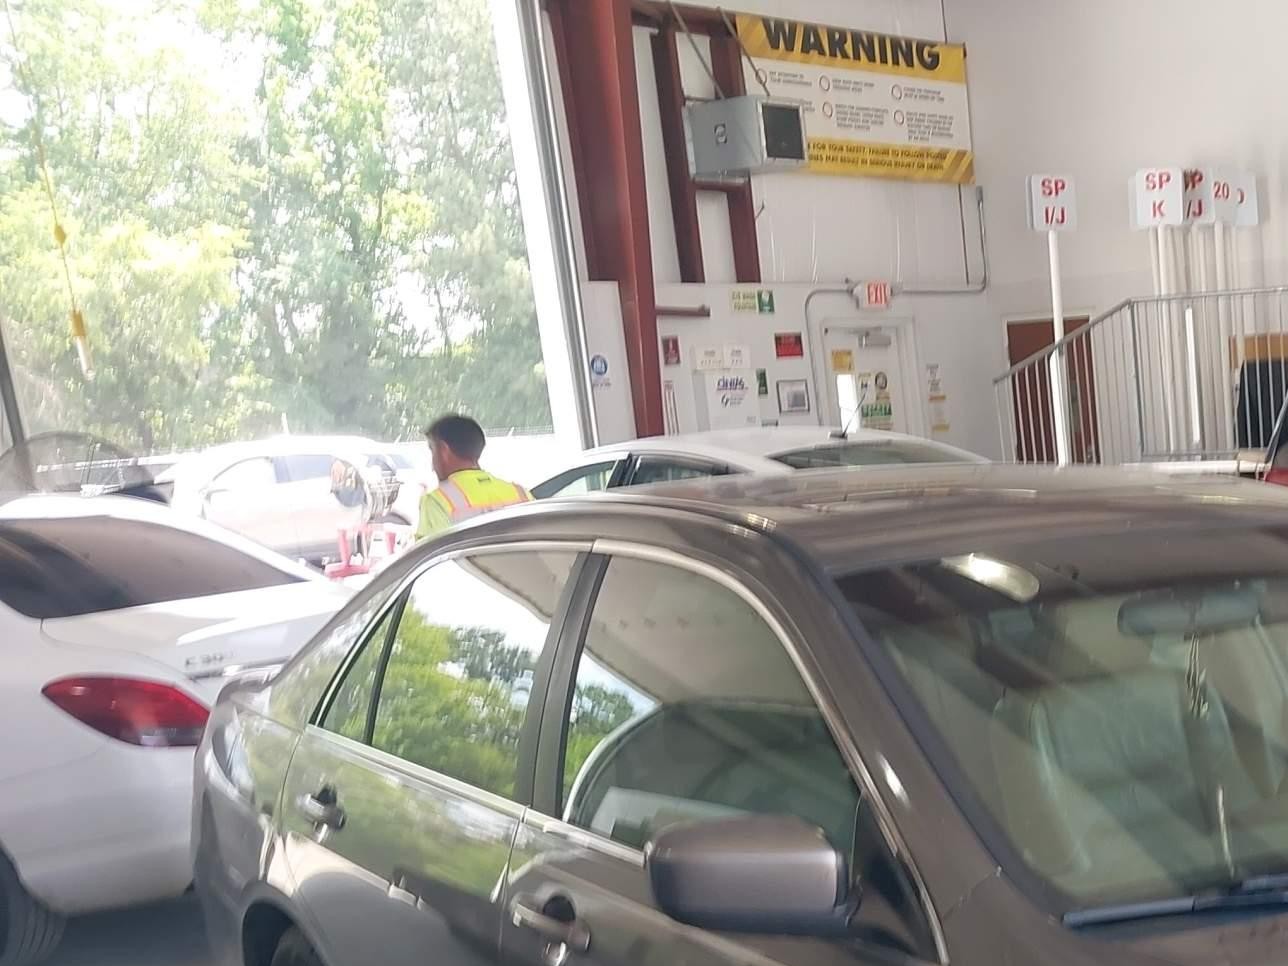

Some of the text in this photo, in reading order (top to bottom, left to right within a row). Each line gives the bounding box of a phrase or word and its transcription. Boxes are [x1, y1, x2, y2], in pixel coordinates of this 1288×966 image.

[761, 17, 941, 71] WARNING
[1041, 178, 1066, 197] SP
[1145, 172, 1171, 191] SP
[1044, 206, 1066, 224] I/J
[1152, 200, 1165, 217] K
